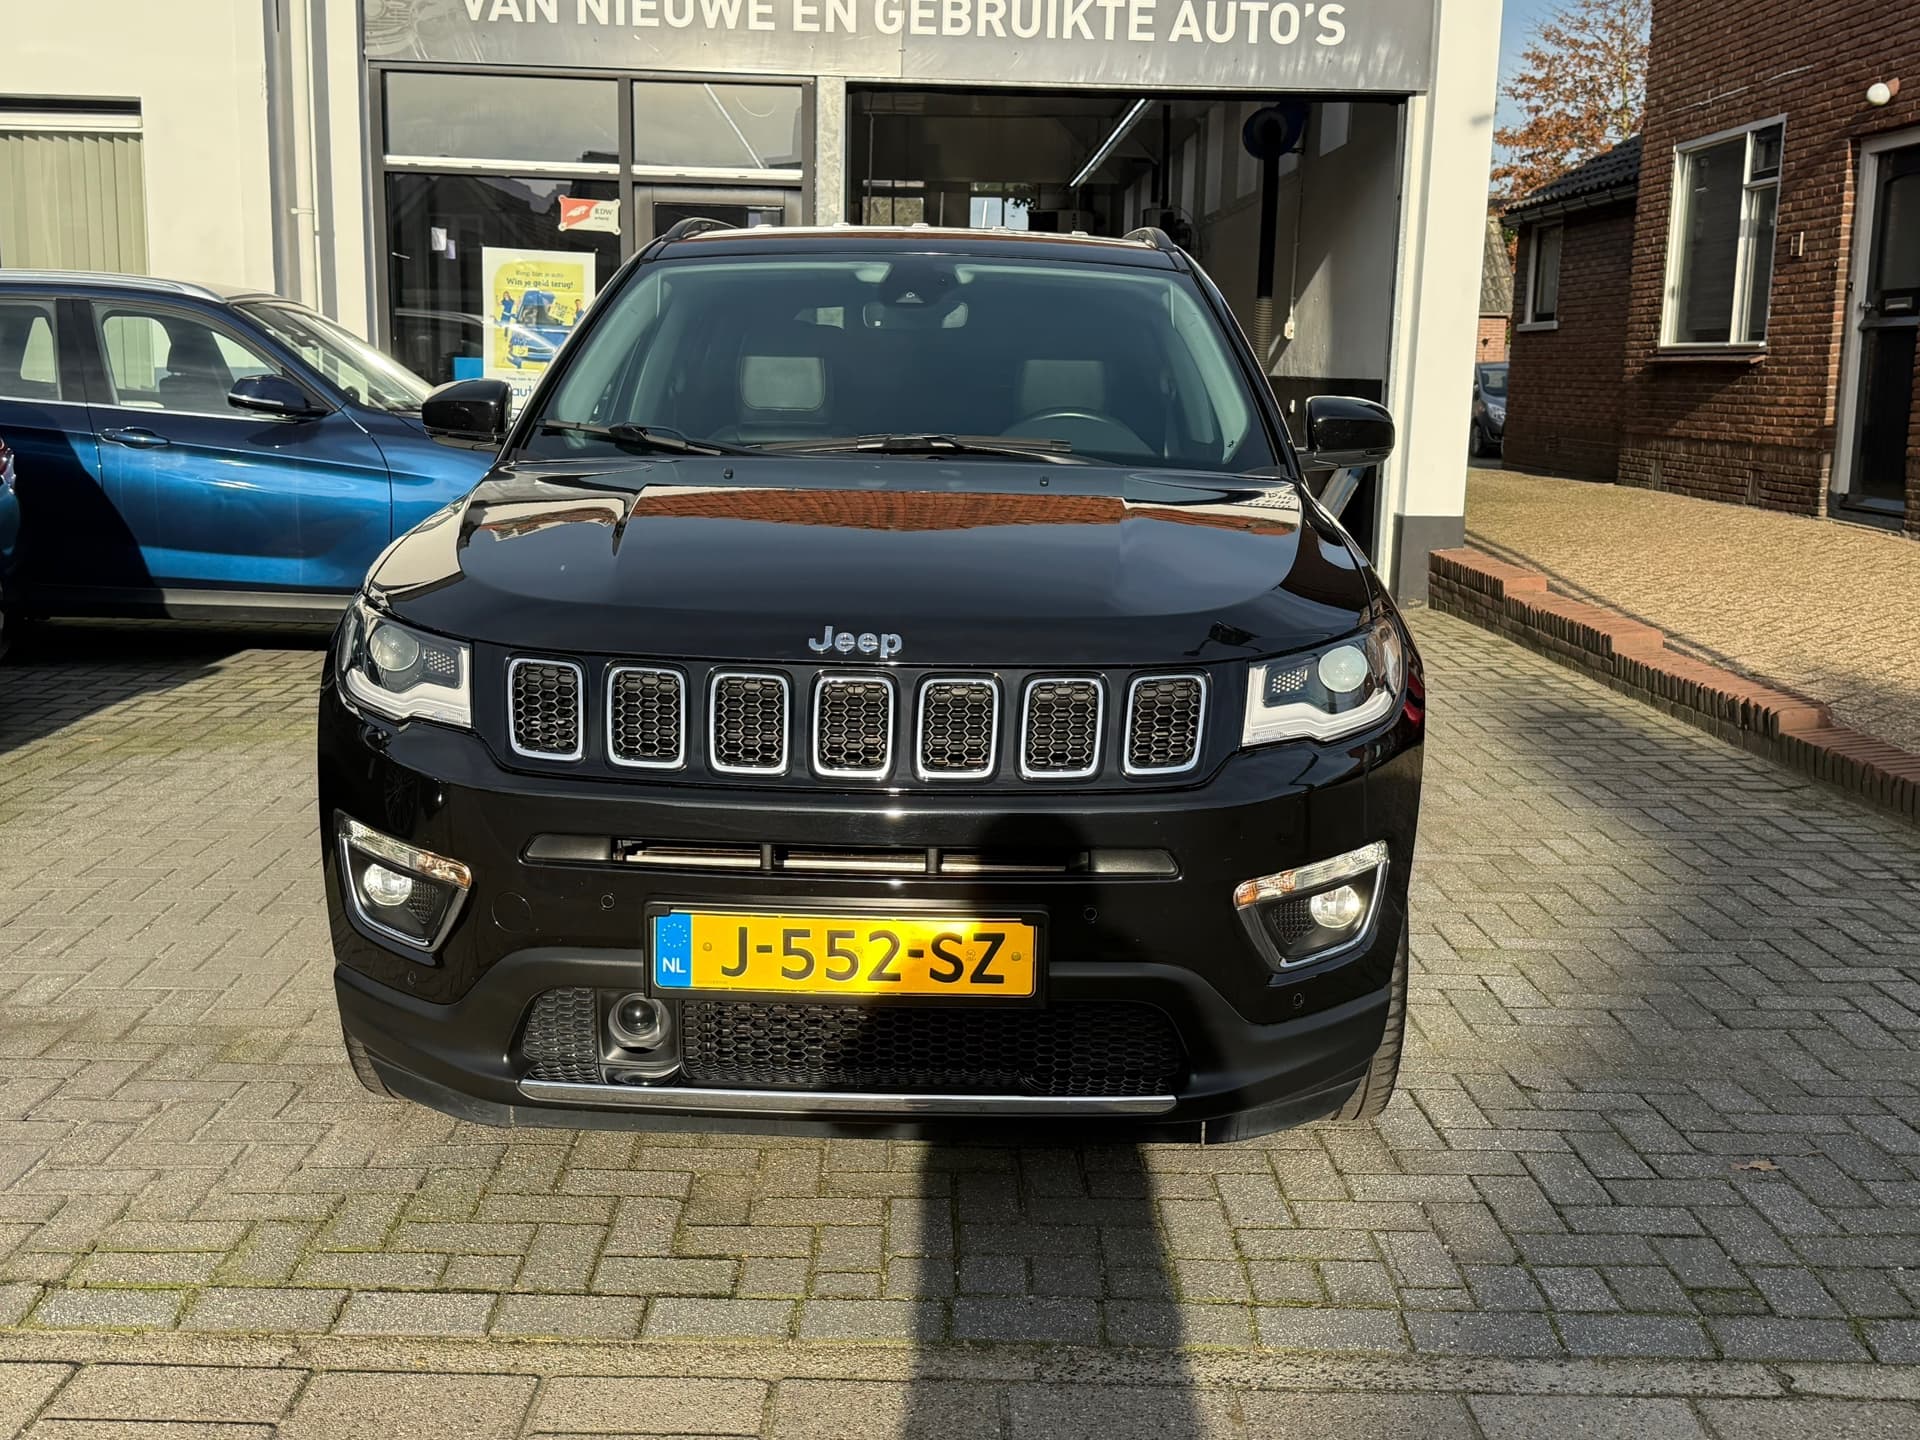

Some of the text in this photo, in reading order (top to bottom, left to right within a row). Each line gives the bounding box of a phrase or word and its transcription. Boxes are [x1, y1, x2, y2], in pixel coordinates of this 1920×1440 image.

[577, 0, 776, 31] NIEUWE
[793, 0, 857, 33] EN
[874, 0, 1156, 41] GEBRUIKTE
[1168, 0, 1346, 46] AUTO'S
[506, 277, 523, 286] Win
[551, 281, 574, 289] terug!
[808, 625, 903, 659] Jeep
[662, 957, 687, 975] NL
[721, 926, 1006, 984] J-552-SZ
